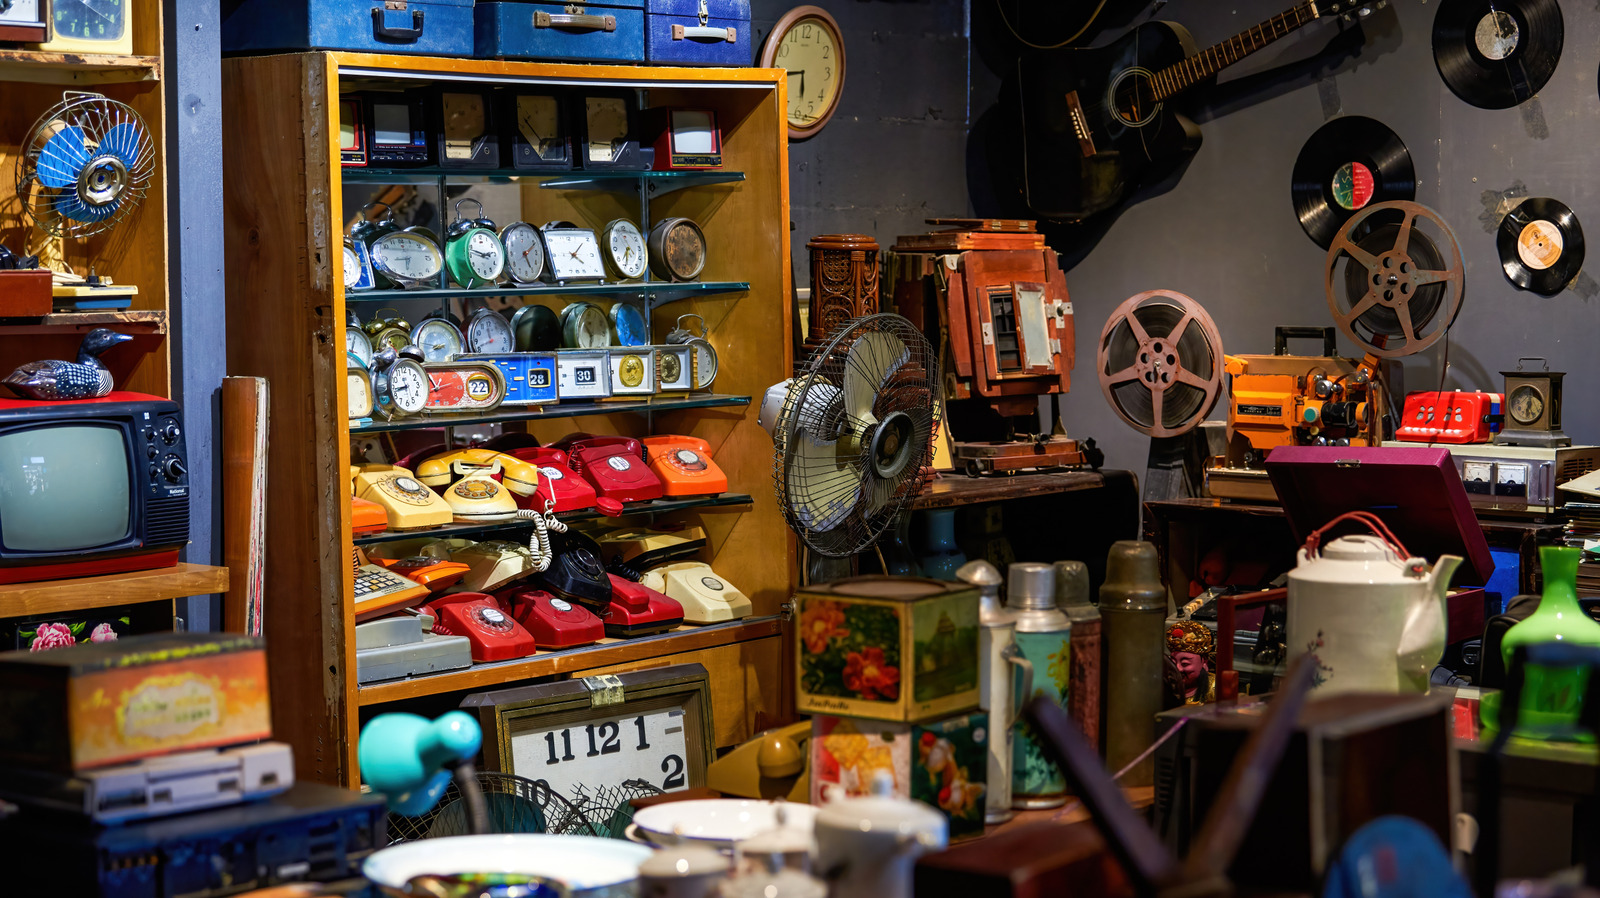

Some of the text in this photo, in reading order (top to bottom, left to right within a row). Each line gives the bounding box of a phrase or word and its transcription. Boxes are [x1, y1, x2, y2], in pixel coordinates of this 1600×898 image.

[110, 14, 115, 23] 4
[70, 22, 76, 32] 7
[84, 27, 89, 37] 6
[99, 24, 104, 34] 5
[802, 25, 812, 39] 12
[790, 29, 798, 42] 11
[816, 30, 820, 44] 1
[778, 44, 789, 57] 10
[822, 45, 830, 59] 2
[824, 67, 831, 81] 3
[818, 88, 824, 102] 4
[794, 105, 801, 119] 6
[808, 101, 814, 114] 5
[530, 374, 544, 384] 28
[577, 370, 590, 381] 30
[471, 382, 486, 393] 22
[586, 722, 620, 757] 12
[634, 716, 650, 750] 1
[544, 728, 575, 765] 11
[661, 754, 685, 790] 2
